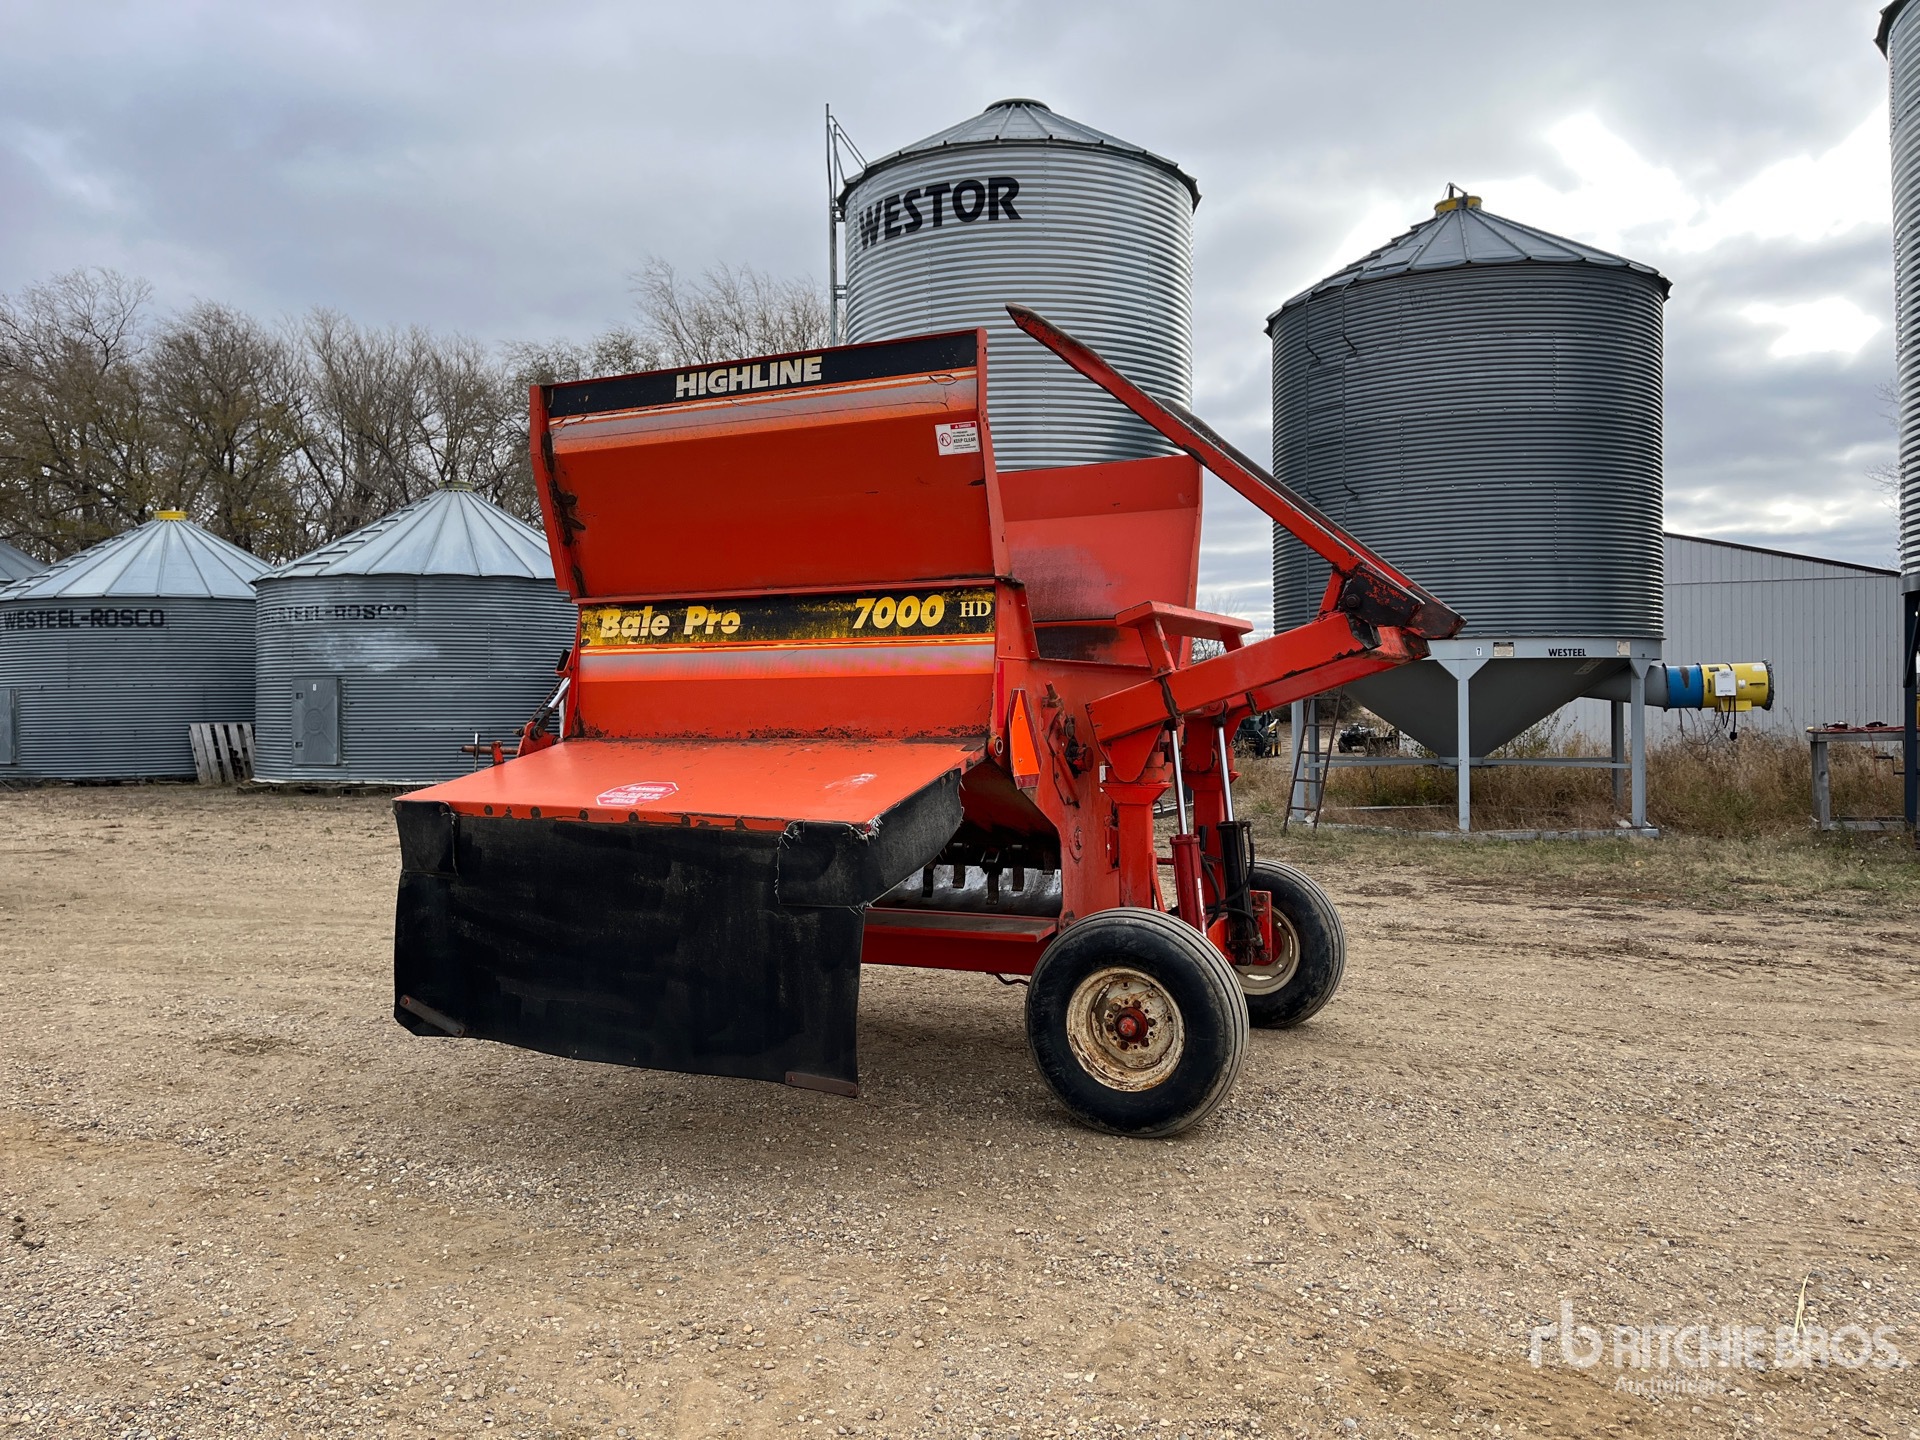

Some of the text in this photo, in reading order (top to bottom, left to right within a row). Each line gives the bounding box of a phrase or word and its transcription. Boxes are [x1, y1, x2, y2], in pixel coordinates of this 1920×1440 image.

[858, 176, 1023, 251] WESTOR
[675, 355, 823, 399] HIGHLINE
[3, 608, 166, 631] WESTEEL-ROSCO
[600, 594, 992, 638] Bale Pro 7000 HD
[1548, 648, 1586, 657] WESTEEL
